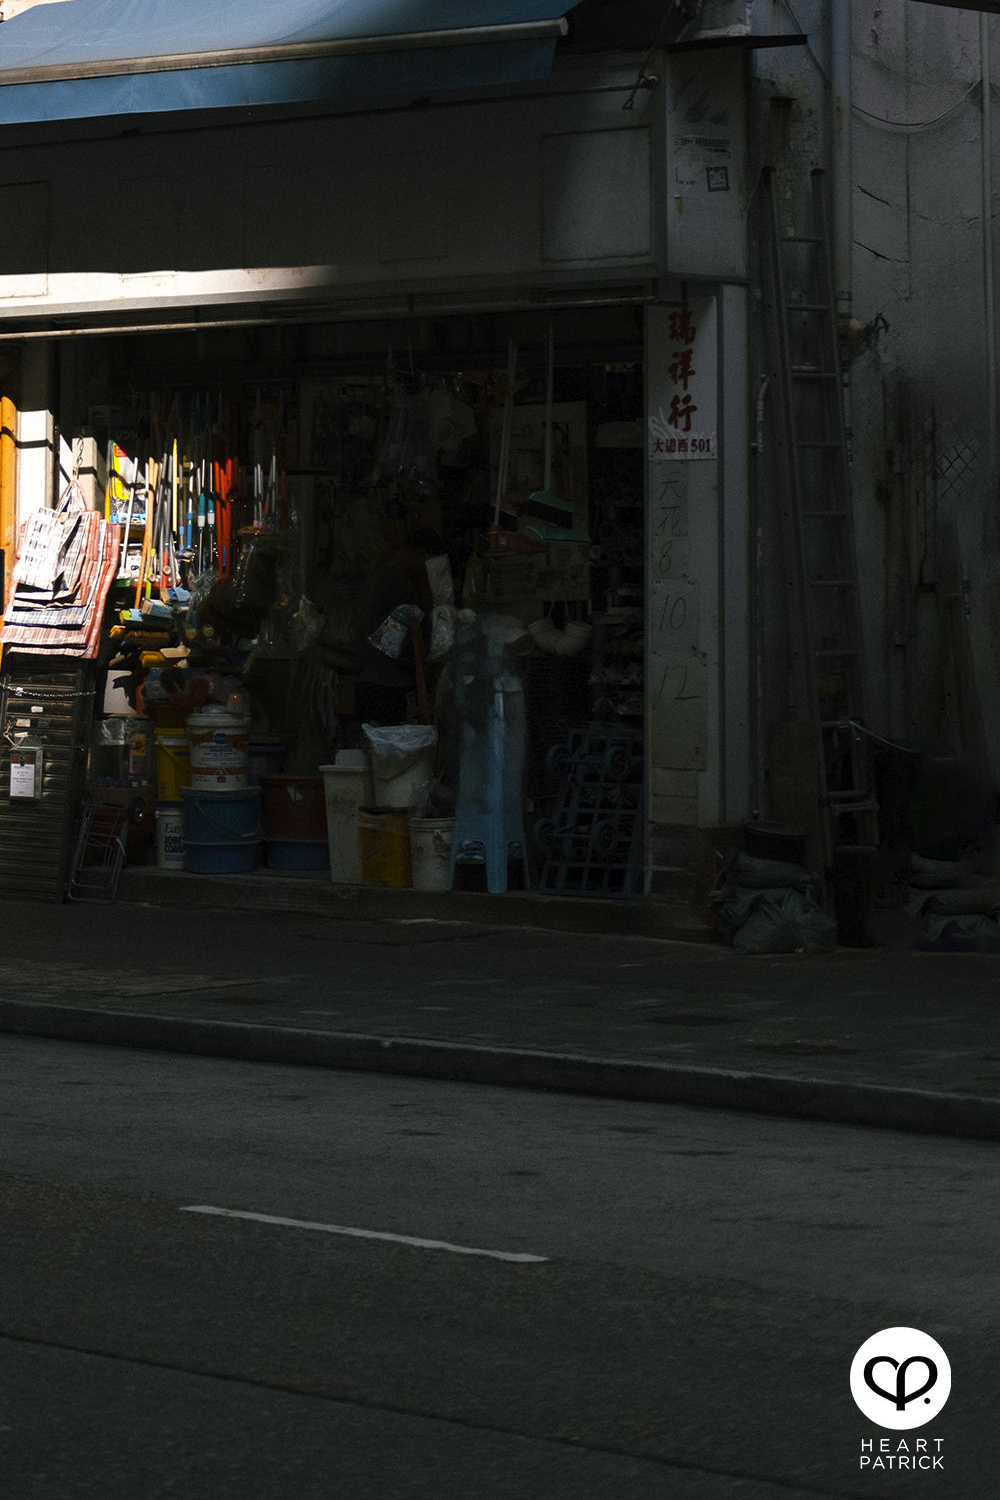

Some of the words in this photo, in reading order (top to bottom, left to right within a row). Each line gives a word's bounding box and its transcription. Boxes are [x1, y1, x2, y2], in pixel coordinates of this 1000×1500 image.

[668, 307, 698, 432] 瑞祥行
[653, 438, 689, 454] 大道西
[690, 438, 711, 453] 501
[659, 594, 687, 632] 10
[658, 665, 701, 701] 12
